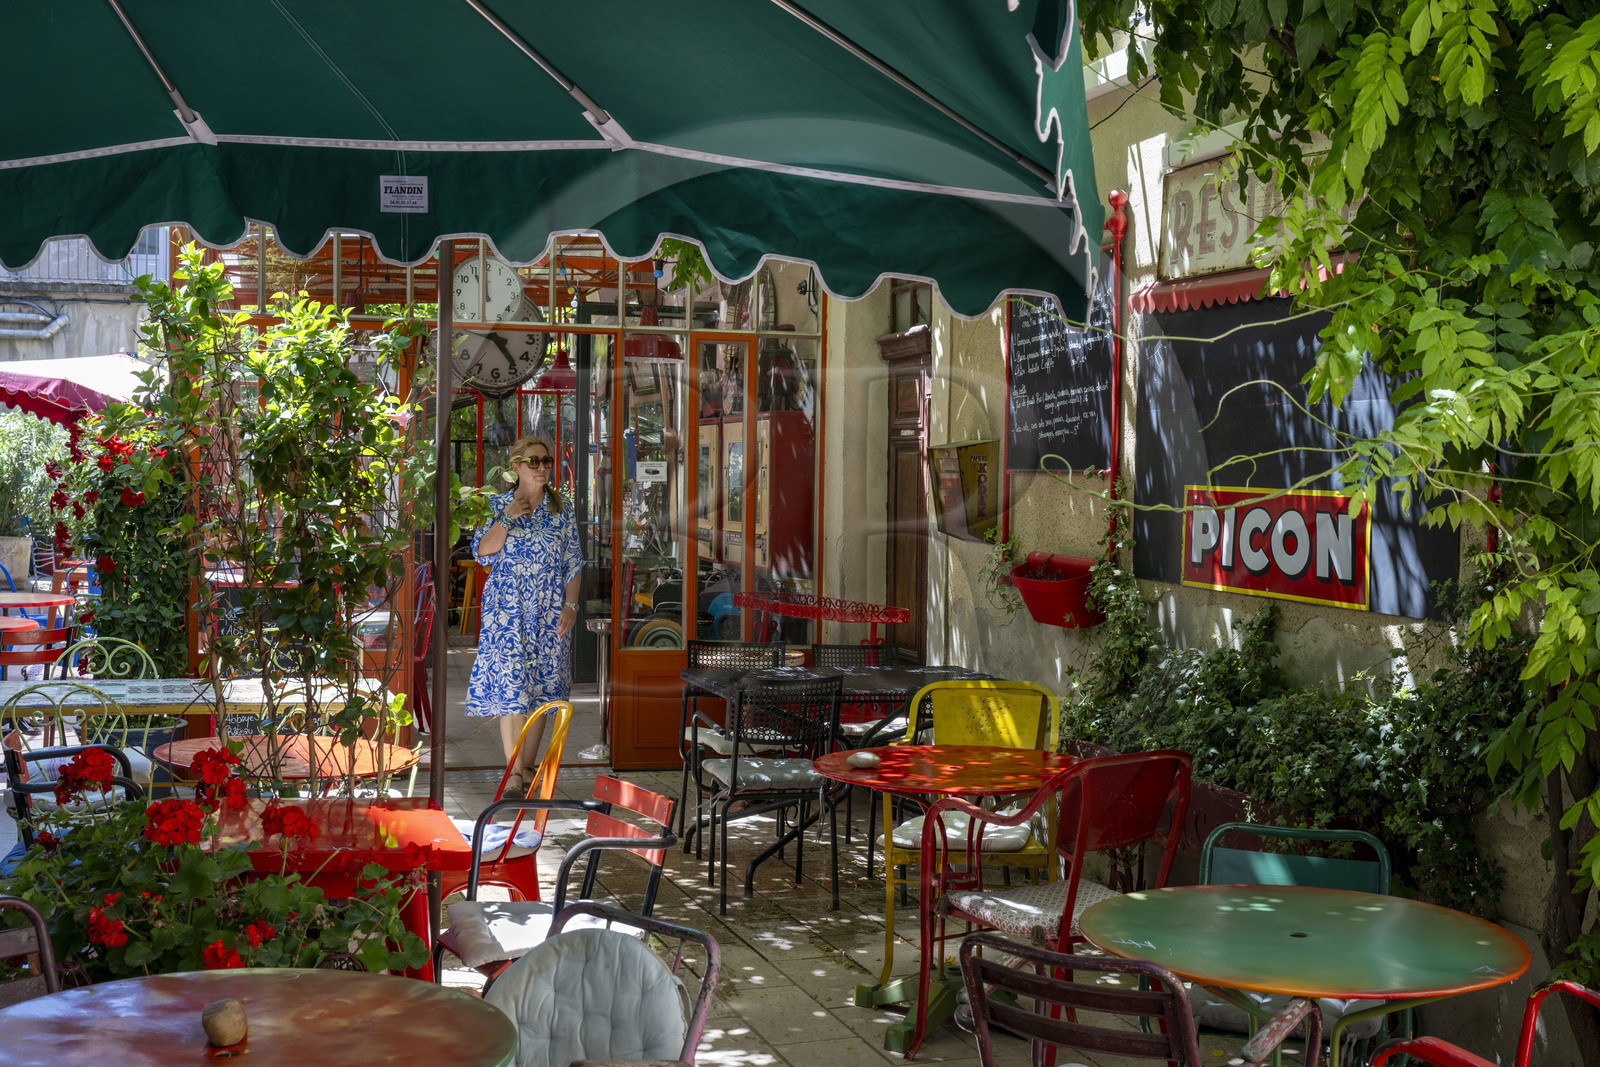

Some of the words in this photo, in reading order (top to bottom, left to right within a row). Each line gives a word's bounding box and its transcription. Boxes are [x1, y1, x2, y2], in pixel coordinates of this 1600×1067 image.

[460, 275, 469, 283] 10
[507, 278, 512, 286] 2
[456, 288, 462, 296] 9
[511, 292, 516, 300] 3
[526, 334, 536, 345] 3
[460, 350, 470, 360] 8
[519, 351, 530, 362] 4
[476, 363, 483, 374] 7
[491, 368, 500, 379] 6
[509, 364, 518, 375] 5
[977, 463, 988, 517] KODAK
[1190, 503, 1356, 587] PICON
